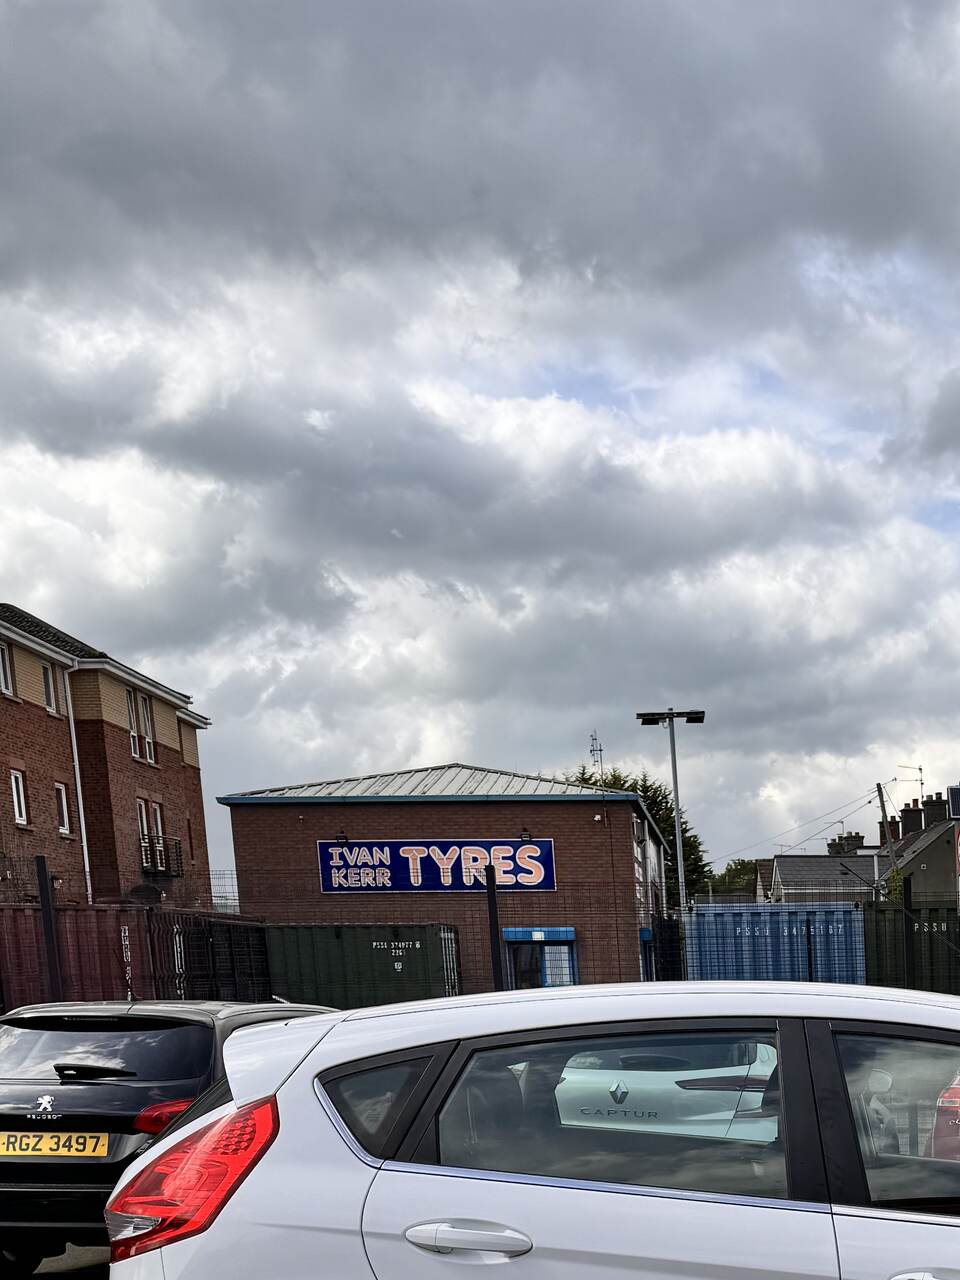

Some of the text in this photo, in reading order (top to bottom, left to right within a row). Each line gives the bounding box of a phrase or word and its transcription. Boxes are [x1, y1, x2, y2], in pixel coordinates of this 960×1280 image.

[328, 846, 391, 866] IVAN
[399, 844, 545, 886] TYRES
[331, 867, 392, 888] KERR
[580, 1108, 658, 1119] CAPTUR
[6, 1134, 101, 1153] RGZ 3497
